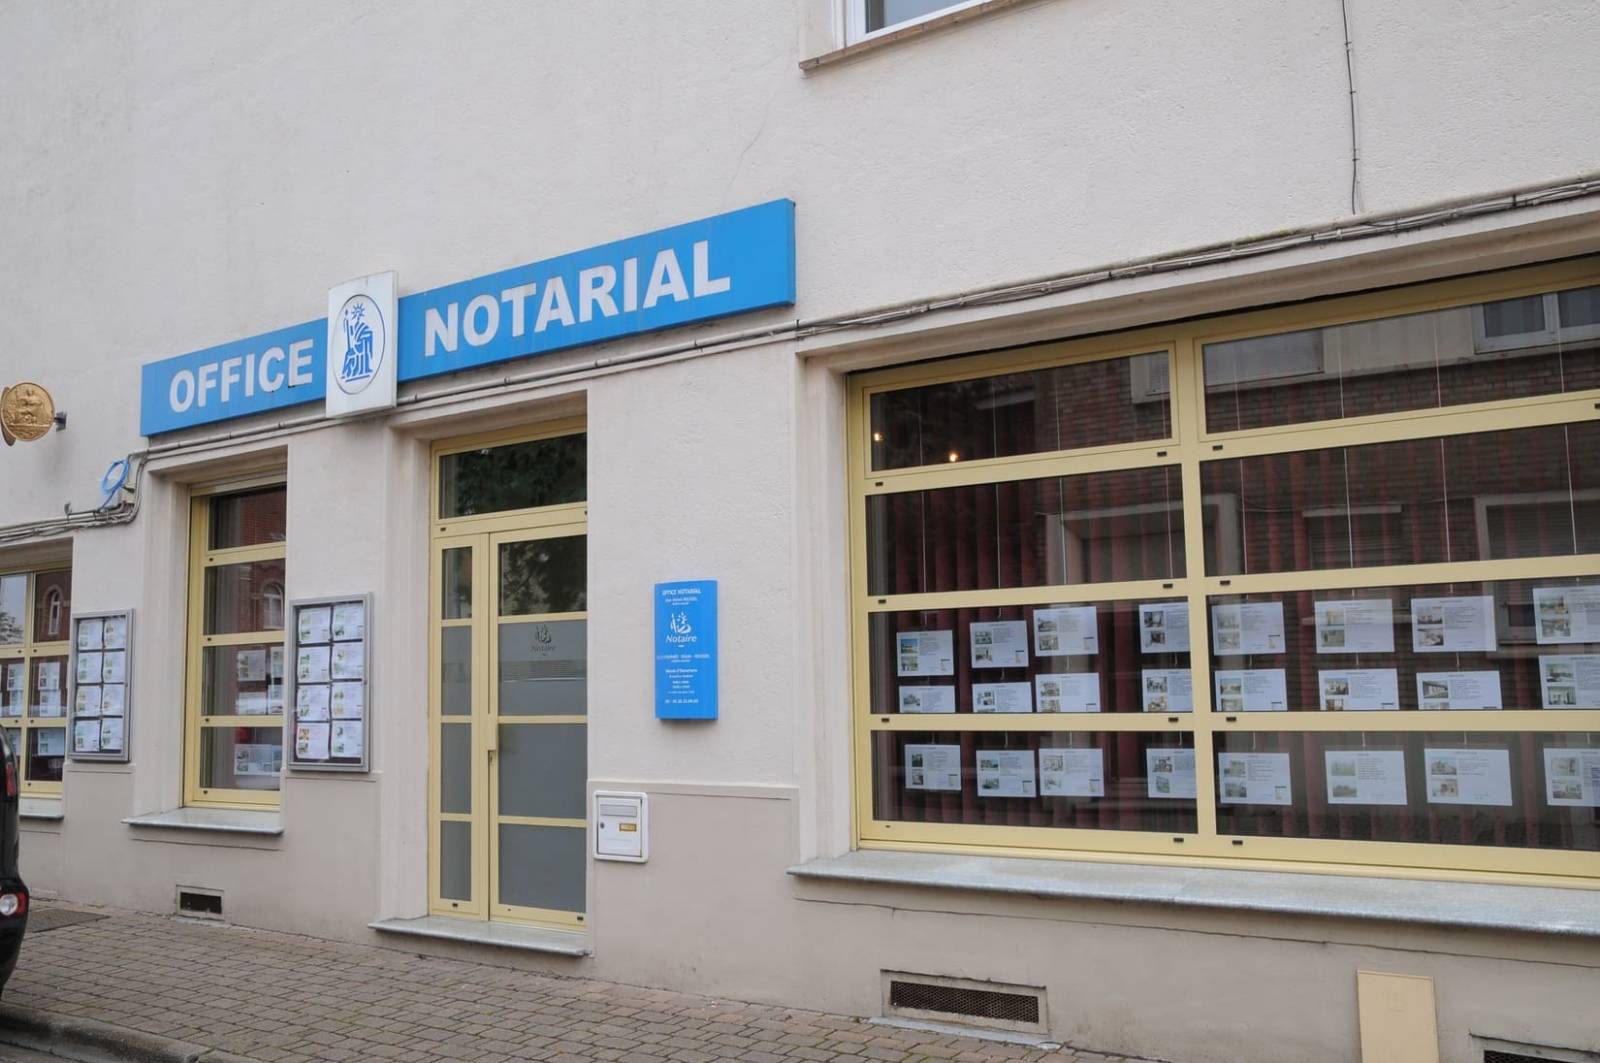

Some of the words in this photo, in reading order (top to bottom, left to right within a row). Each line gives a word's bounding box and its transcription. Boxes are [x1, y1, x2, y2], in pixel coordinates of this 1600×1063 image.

[169, 339, 314, 414] OFFICE
[425, 240, 732, 357] NOTARIAL
[665, 634, 698, 643] Notaire
